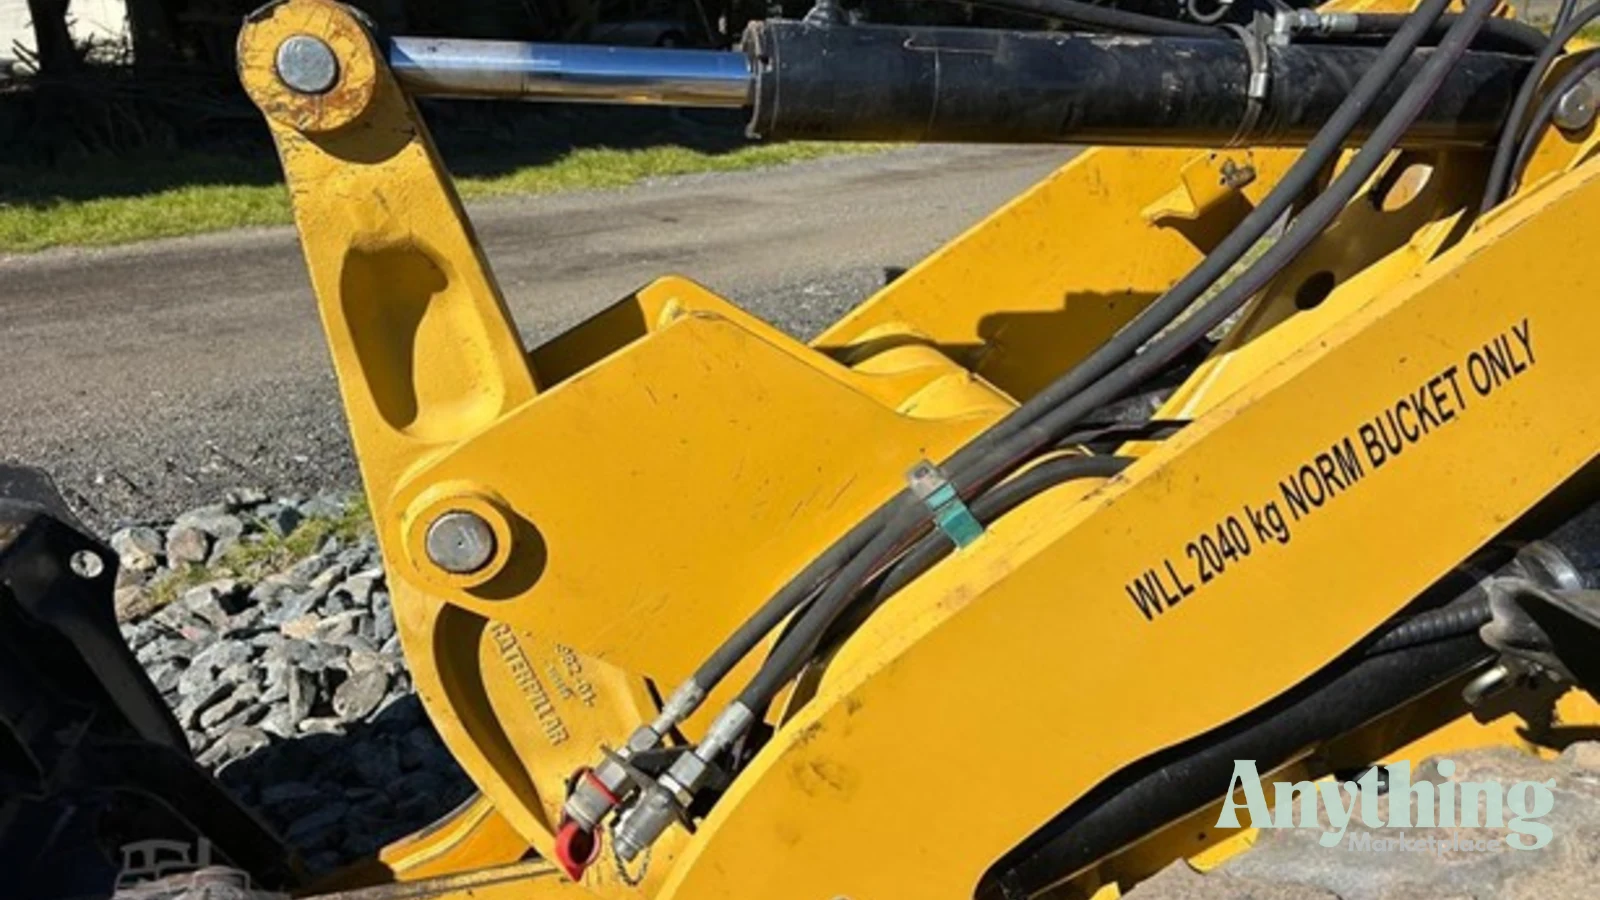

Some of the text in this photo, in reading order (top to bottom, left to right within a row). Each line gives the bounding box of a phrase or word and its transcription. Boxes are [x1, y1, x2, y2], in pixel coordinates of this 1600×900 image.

[1125, 318, 1536, 622] WLL 2040 kg NORM BUCKET ONLY
[491, 622, 570, 746] CATERPILLAR
